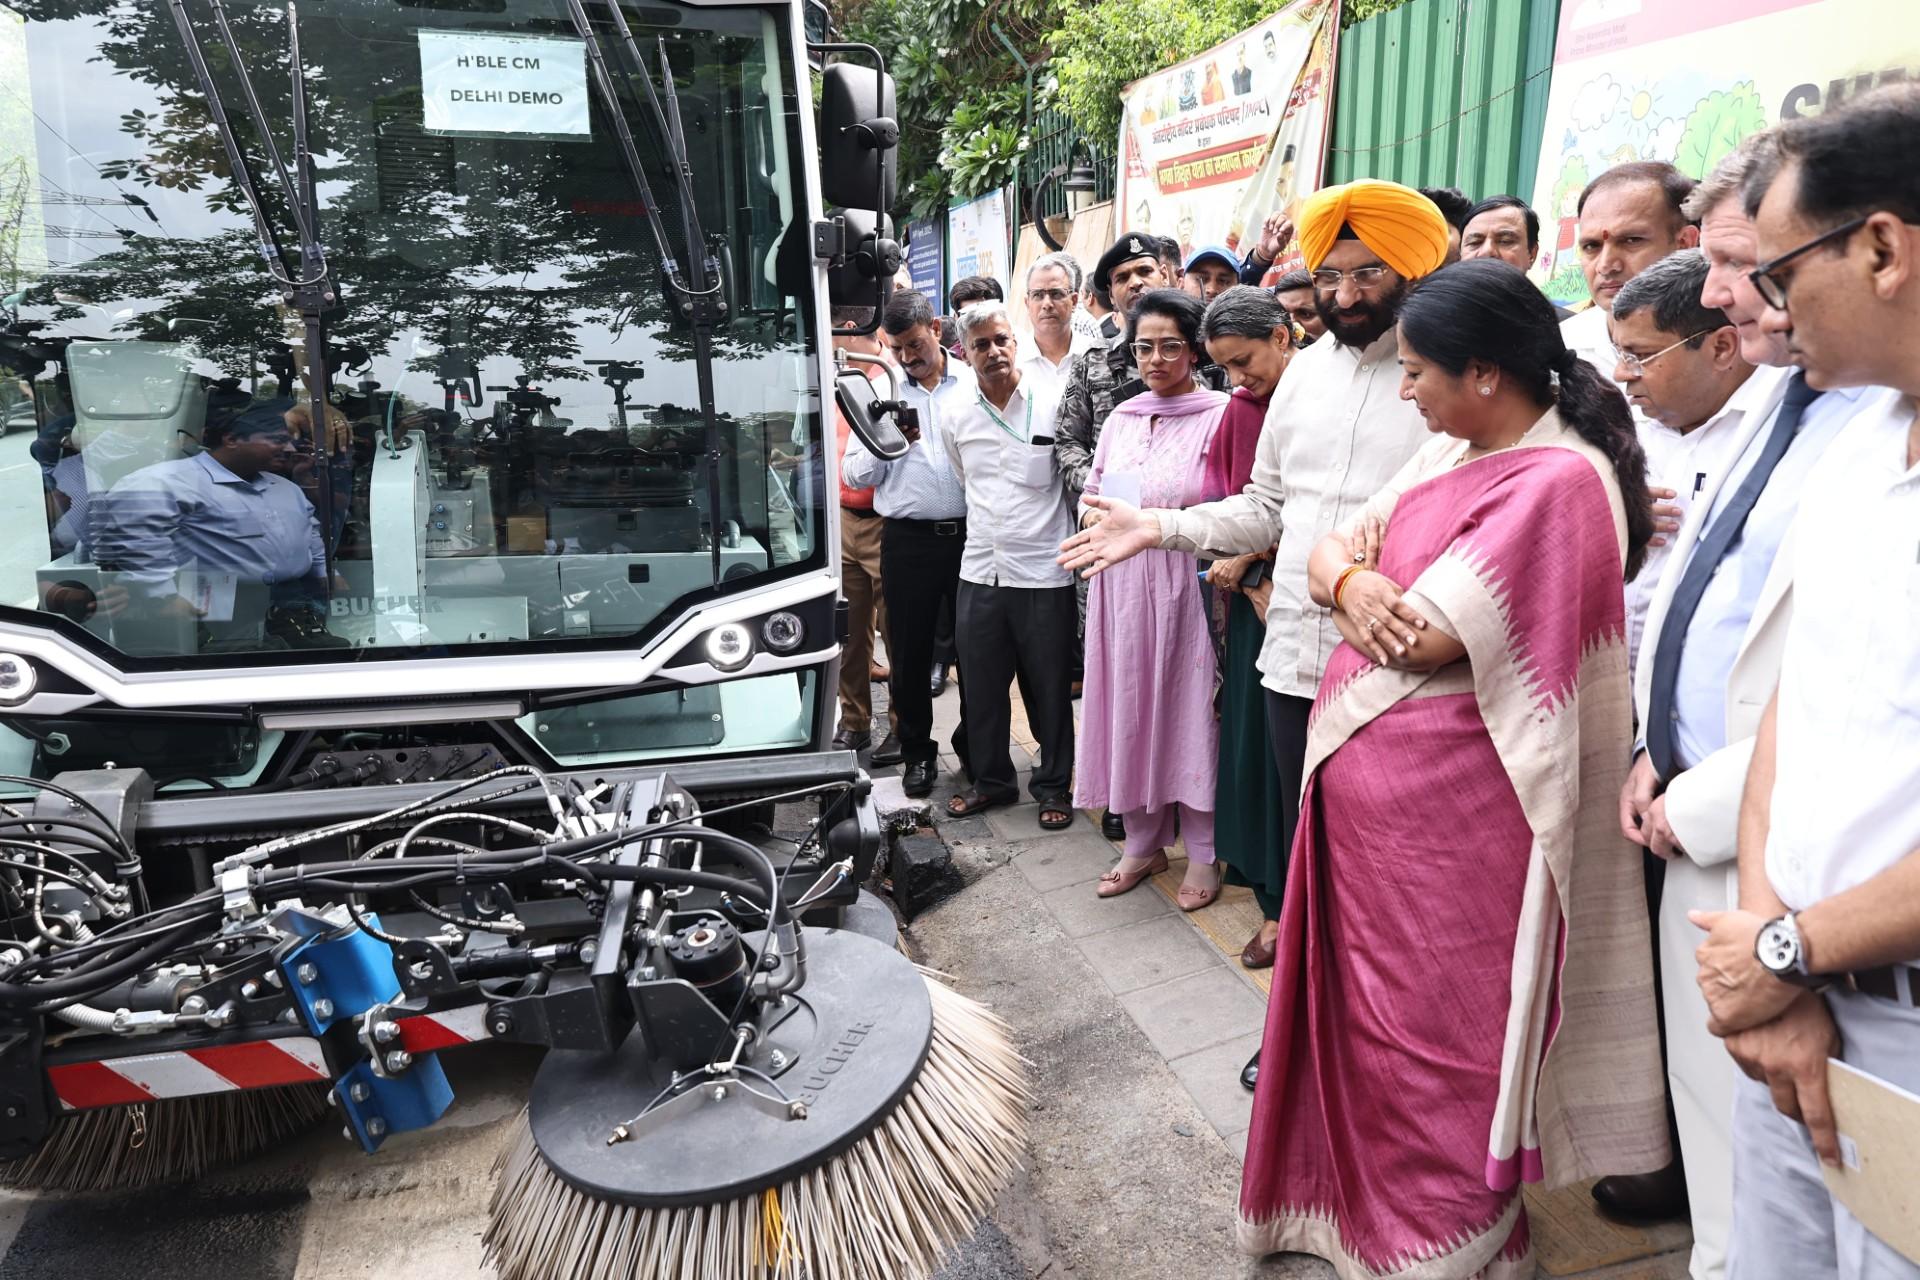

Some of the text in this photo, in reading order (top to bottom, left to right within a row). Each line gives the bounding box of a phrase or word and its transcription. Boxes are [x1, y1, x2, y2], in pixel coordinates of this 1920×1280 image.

[457, 55, 540, 70] H'BLE CM
[451, 90, 563, 105] DELHI DEMO
